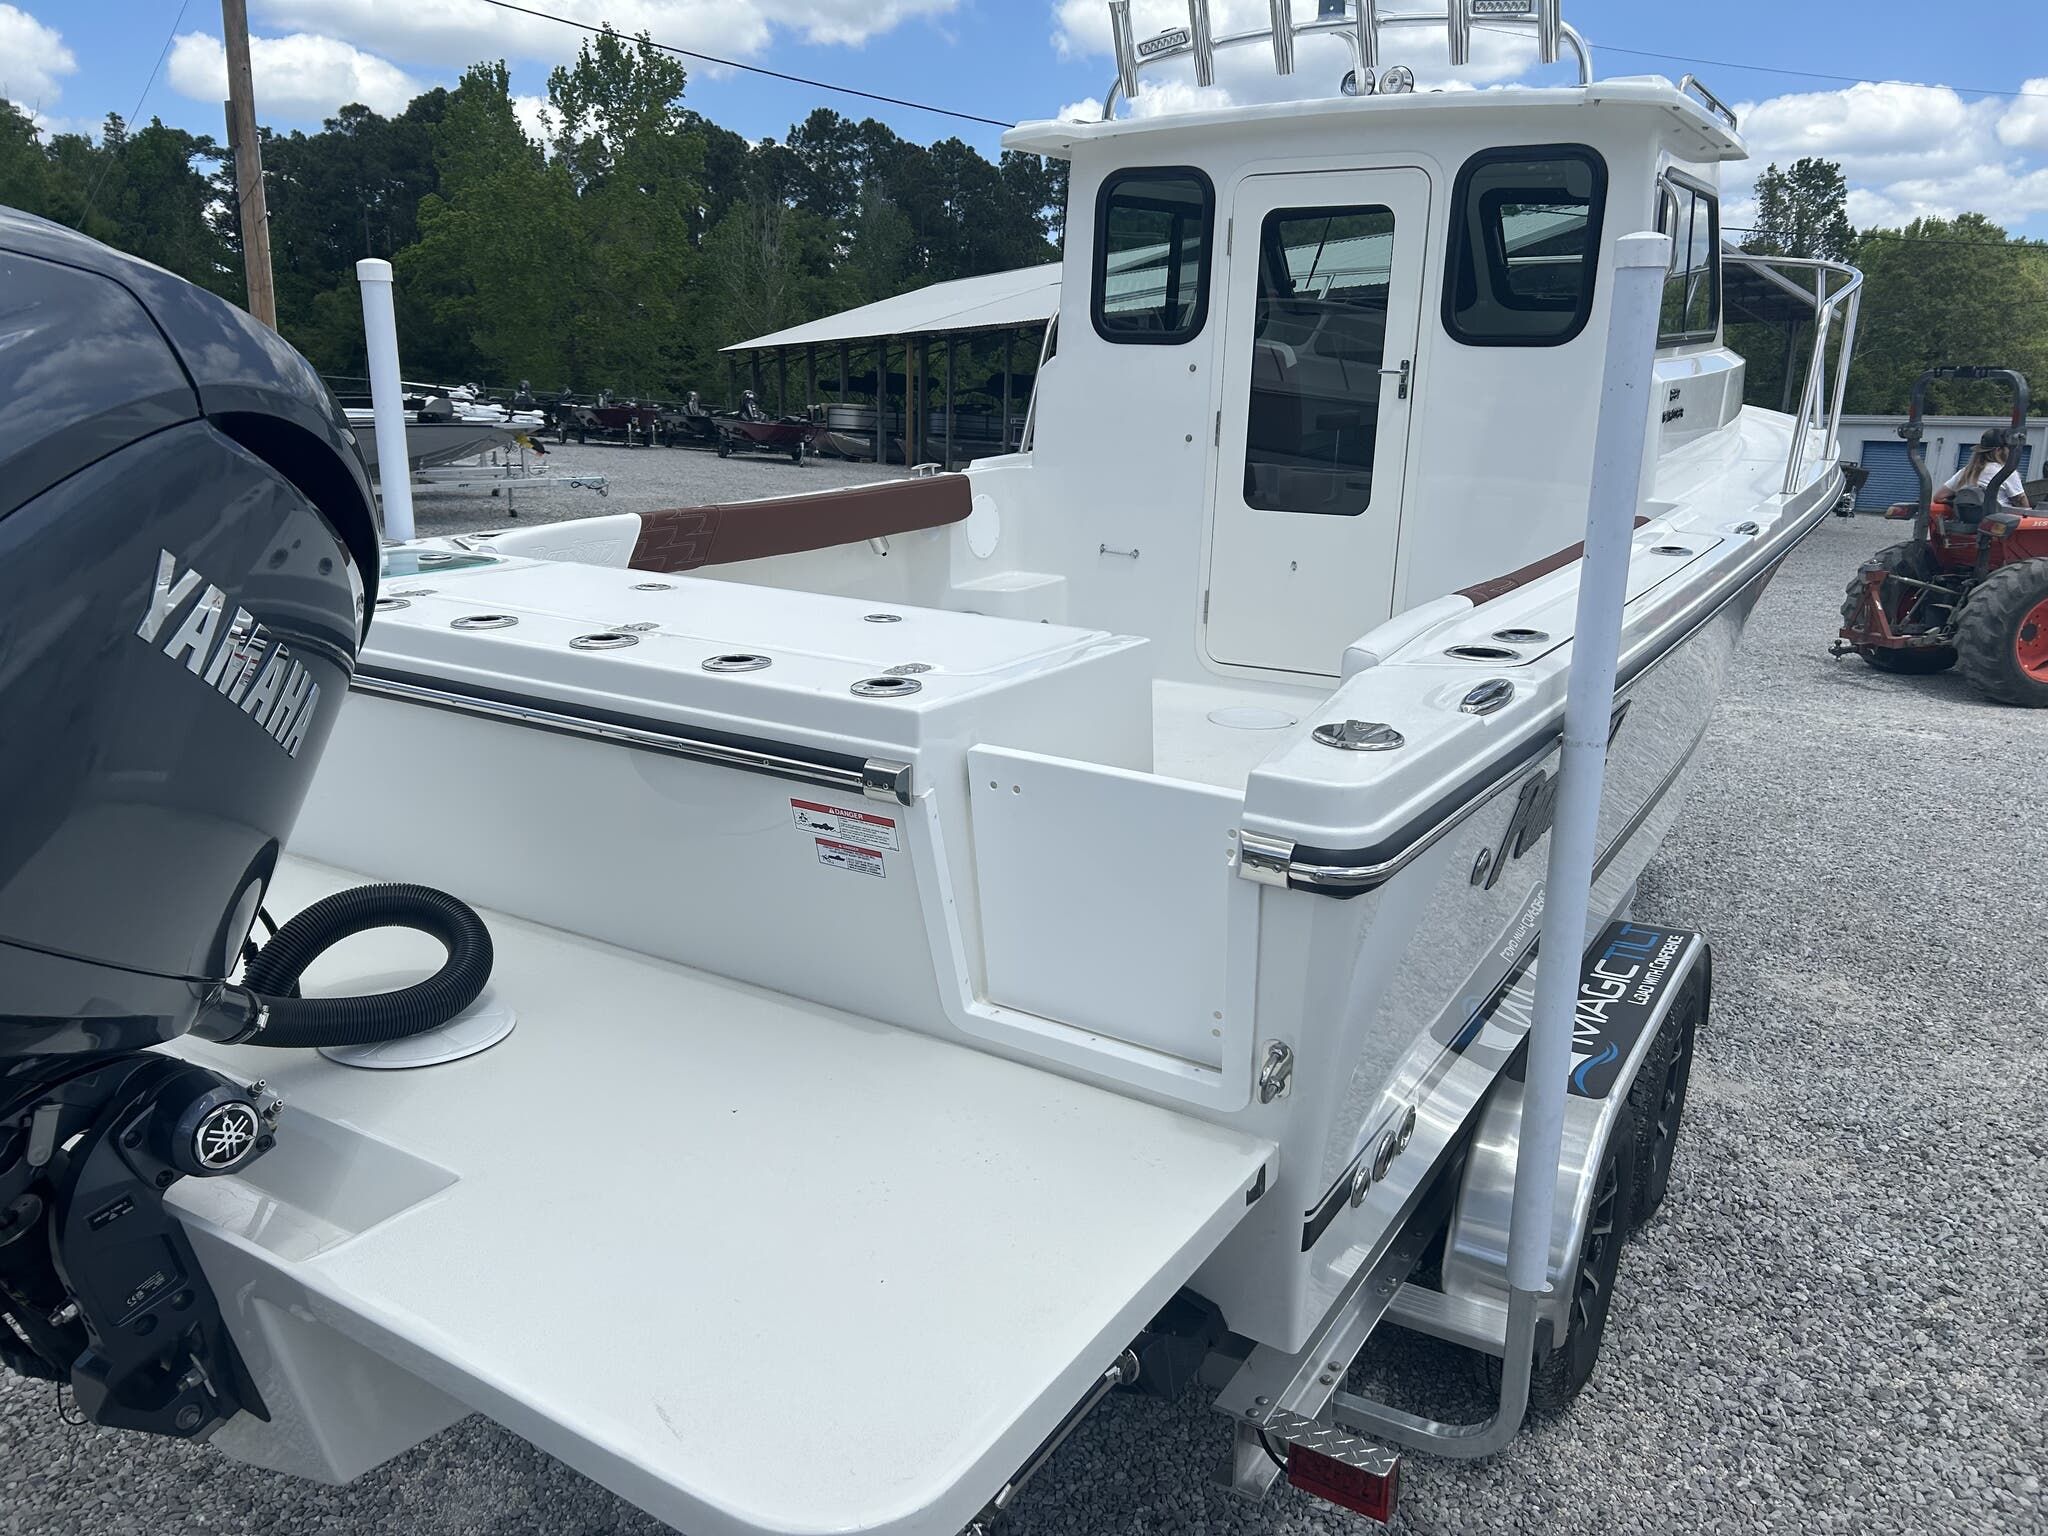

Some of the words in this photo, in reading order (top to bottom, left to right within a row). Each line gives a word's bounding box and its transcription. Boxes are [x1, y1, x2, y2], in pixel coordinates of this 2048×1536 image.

[134, 548, 321, 759] YAMAHA
[835, 808, 864, 820] DANGER
[1627, 984, 1655, 1006] LOAD
